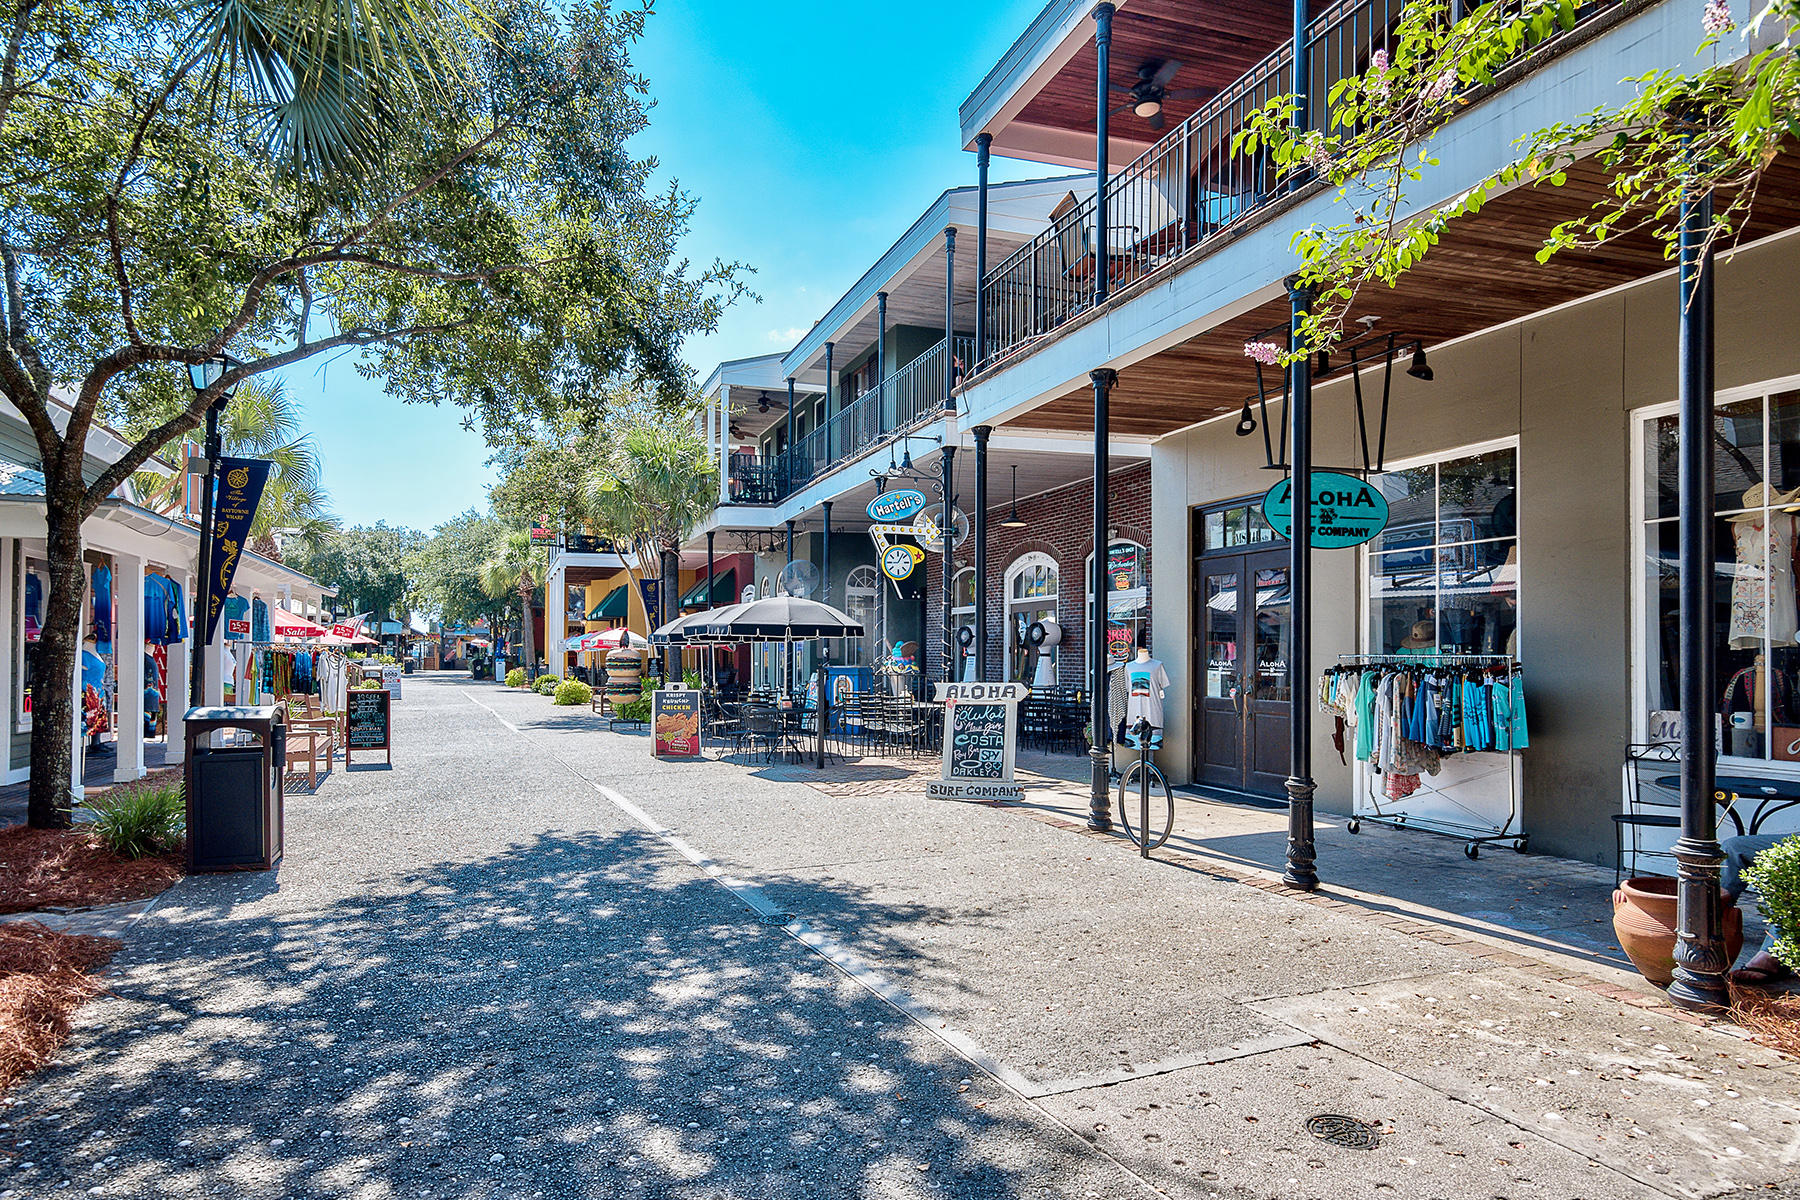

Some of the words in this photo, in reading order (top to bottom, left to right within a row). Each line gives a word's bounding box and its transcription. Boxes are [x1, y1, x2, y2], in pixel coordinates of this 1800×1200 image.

[875, 495, 921, 517] Hartell's
[1317, 526, 1371, 538] COMPANY
[285, 626, 306, 636] Sale
[1259, 660, 1286, 668] ALOHA
[946, 685, 1017, 700] ALOHA
[954, 734, 1004, 746] COSTA
[981, 750, 1000, 760] SPY
[953, 767, 992, 777] OAKLEY
[930, 785, 964, 796] SURF
[966, 785, 1019, 797] COMPANY
